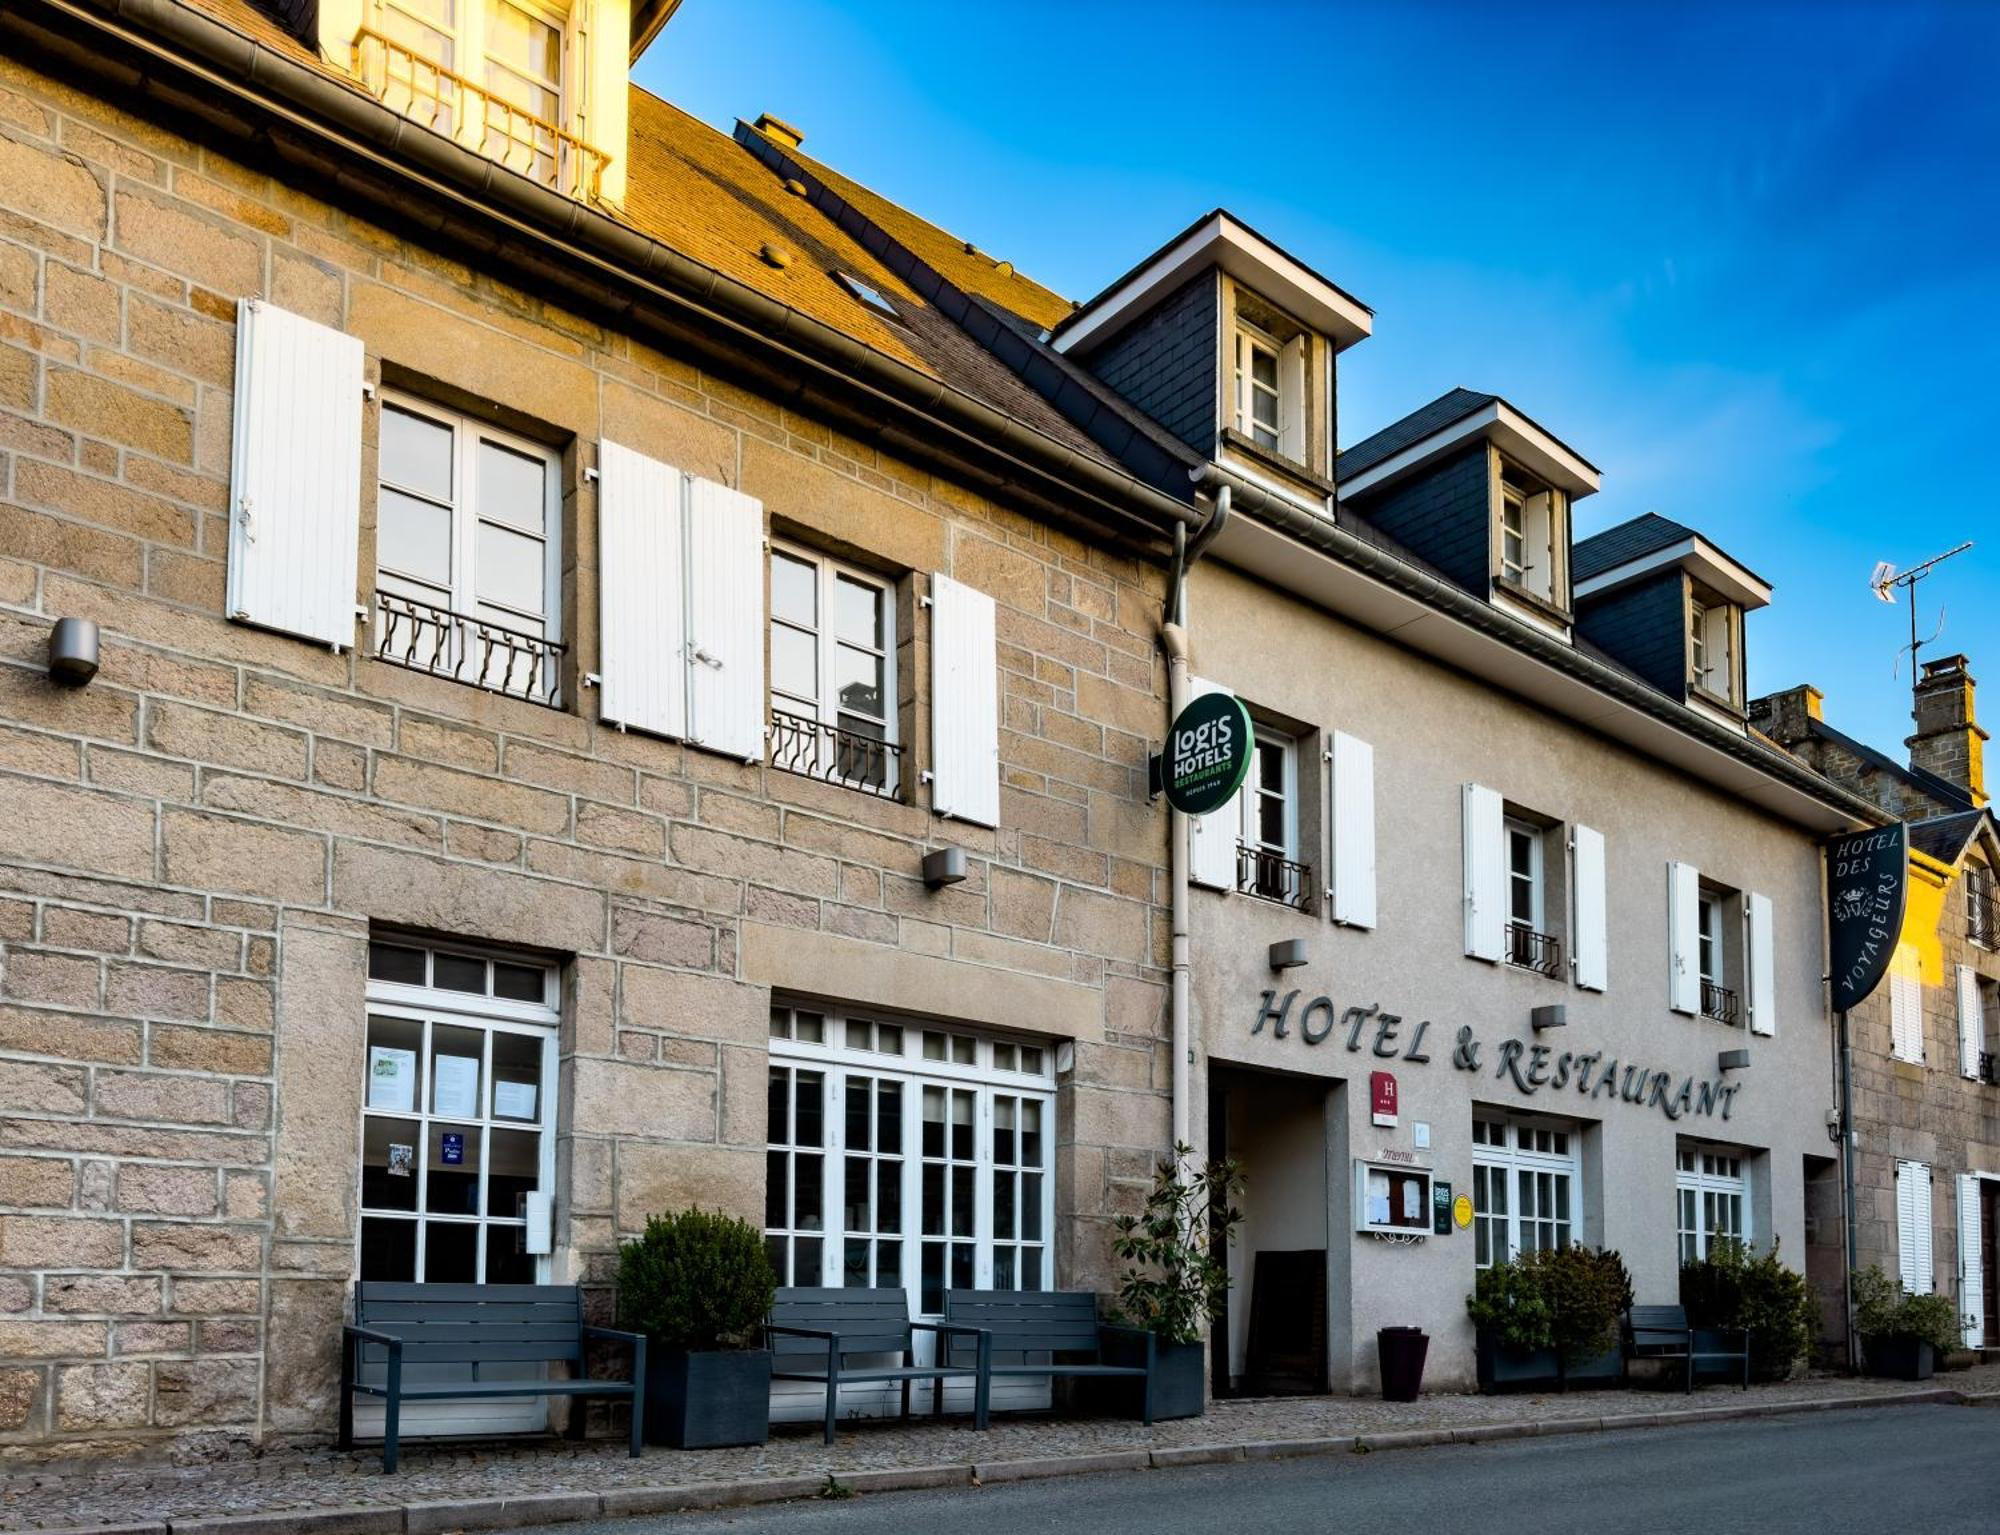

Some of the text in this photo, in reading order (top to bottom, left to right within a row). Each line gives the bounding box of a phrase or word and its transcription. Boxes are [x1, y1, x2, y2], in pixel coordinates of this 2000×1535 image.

[1174, 743, 1232, 779] HOTELS
[1174, 760, 1232, 788] RESTAURANTS
[1836, 831, 1899, 859] HOTEL
[1836, 857, 1872, 877] DES
[1841, 872, 1898, 991] VOYAGEURS
[1251, 989, 1744, 1121] HOTEL & RESTAURANT
[1384, 1081, 1395, 1097] H
